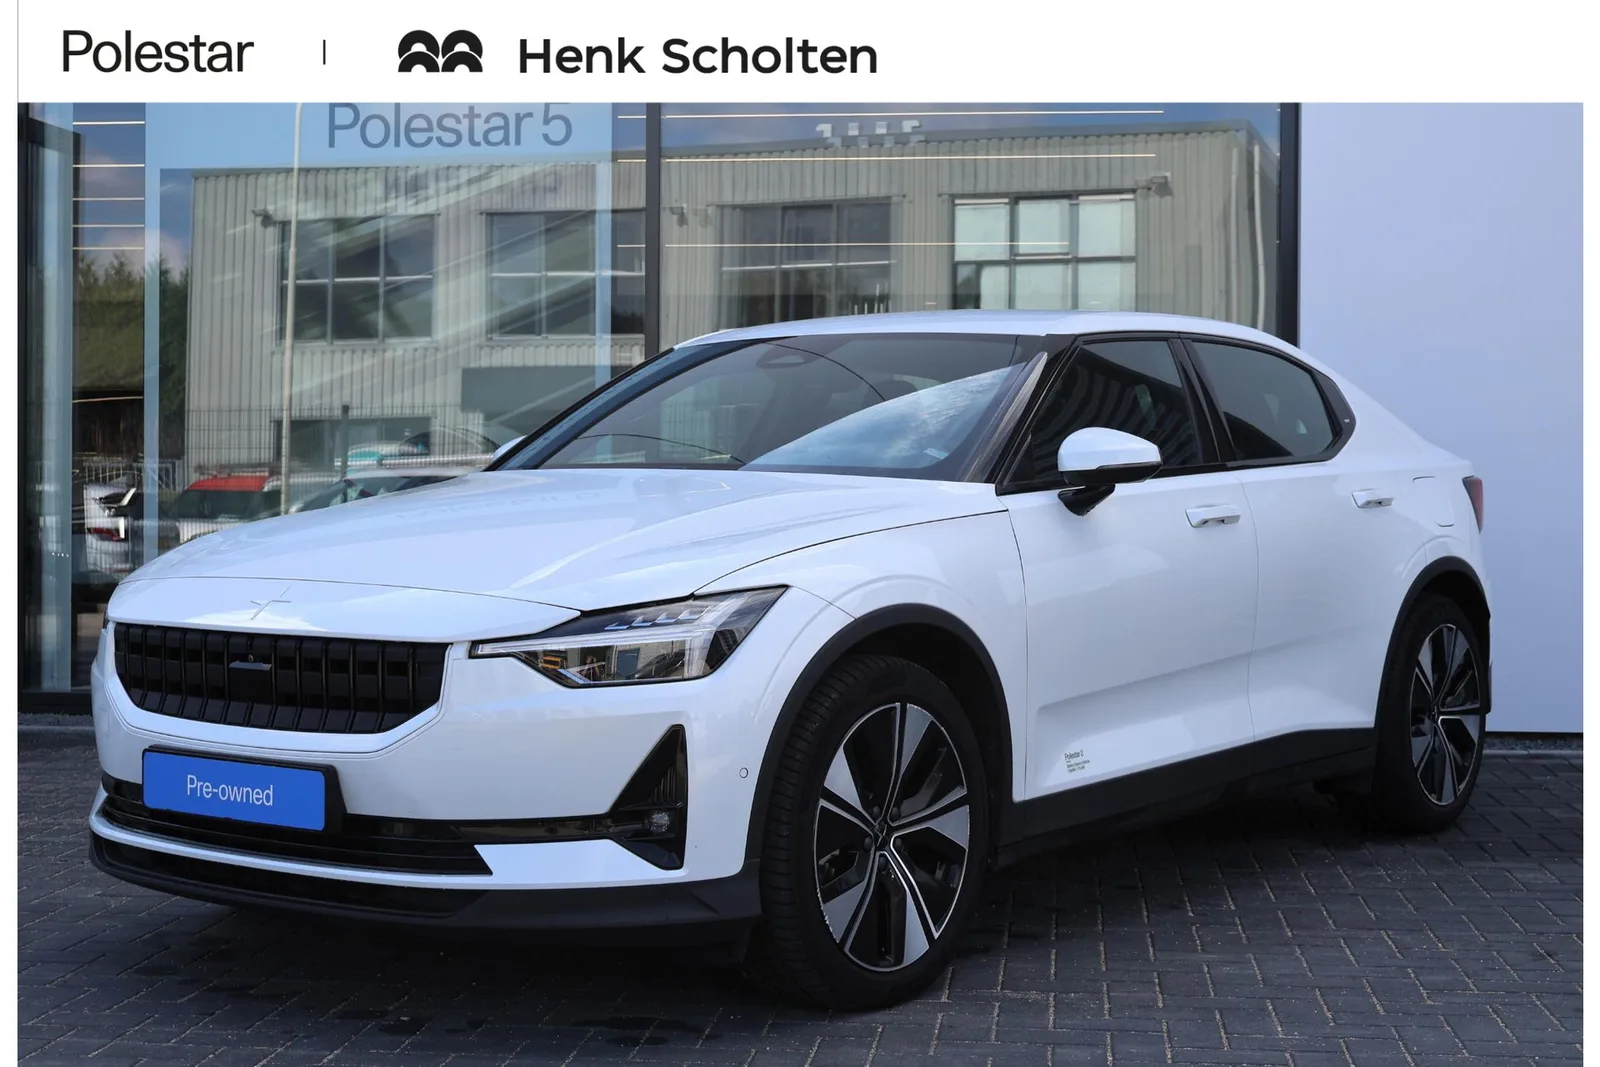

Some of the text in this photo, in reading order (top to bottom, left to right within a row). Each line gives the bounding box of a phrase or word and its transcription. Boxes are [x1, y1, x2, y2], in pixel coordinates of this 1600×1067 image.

[327, 102, 573, 149] Polestar 5
[186, 774, 274, 806] Pre-owned
